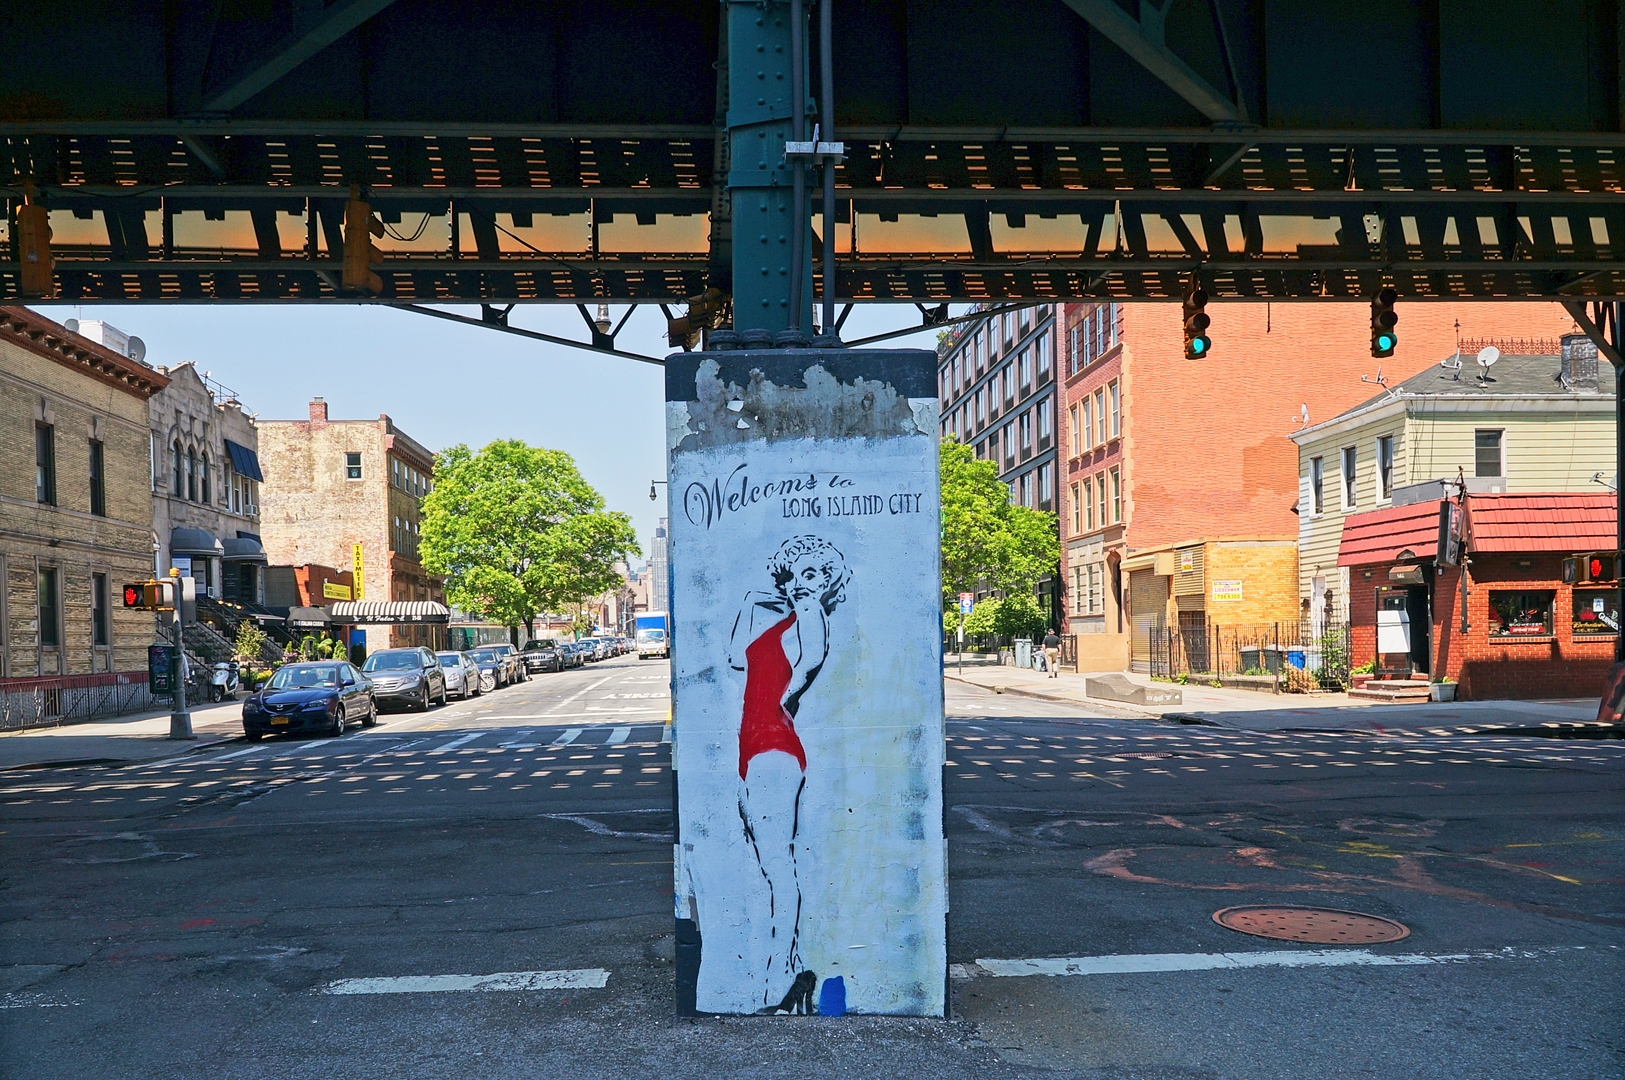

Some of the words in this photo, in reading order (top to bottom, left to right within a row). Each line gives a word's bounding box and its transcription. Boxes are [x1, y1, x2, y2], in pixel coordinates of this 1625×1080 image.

[684, 463, 817, 530] Welcome
[783, 497, 822, 518] LONG
[828, 494, 883, 517] ISLAND
[888, 493, 922, 515] CITY
